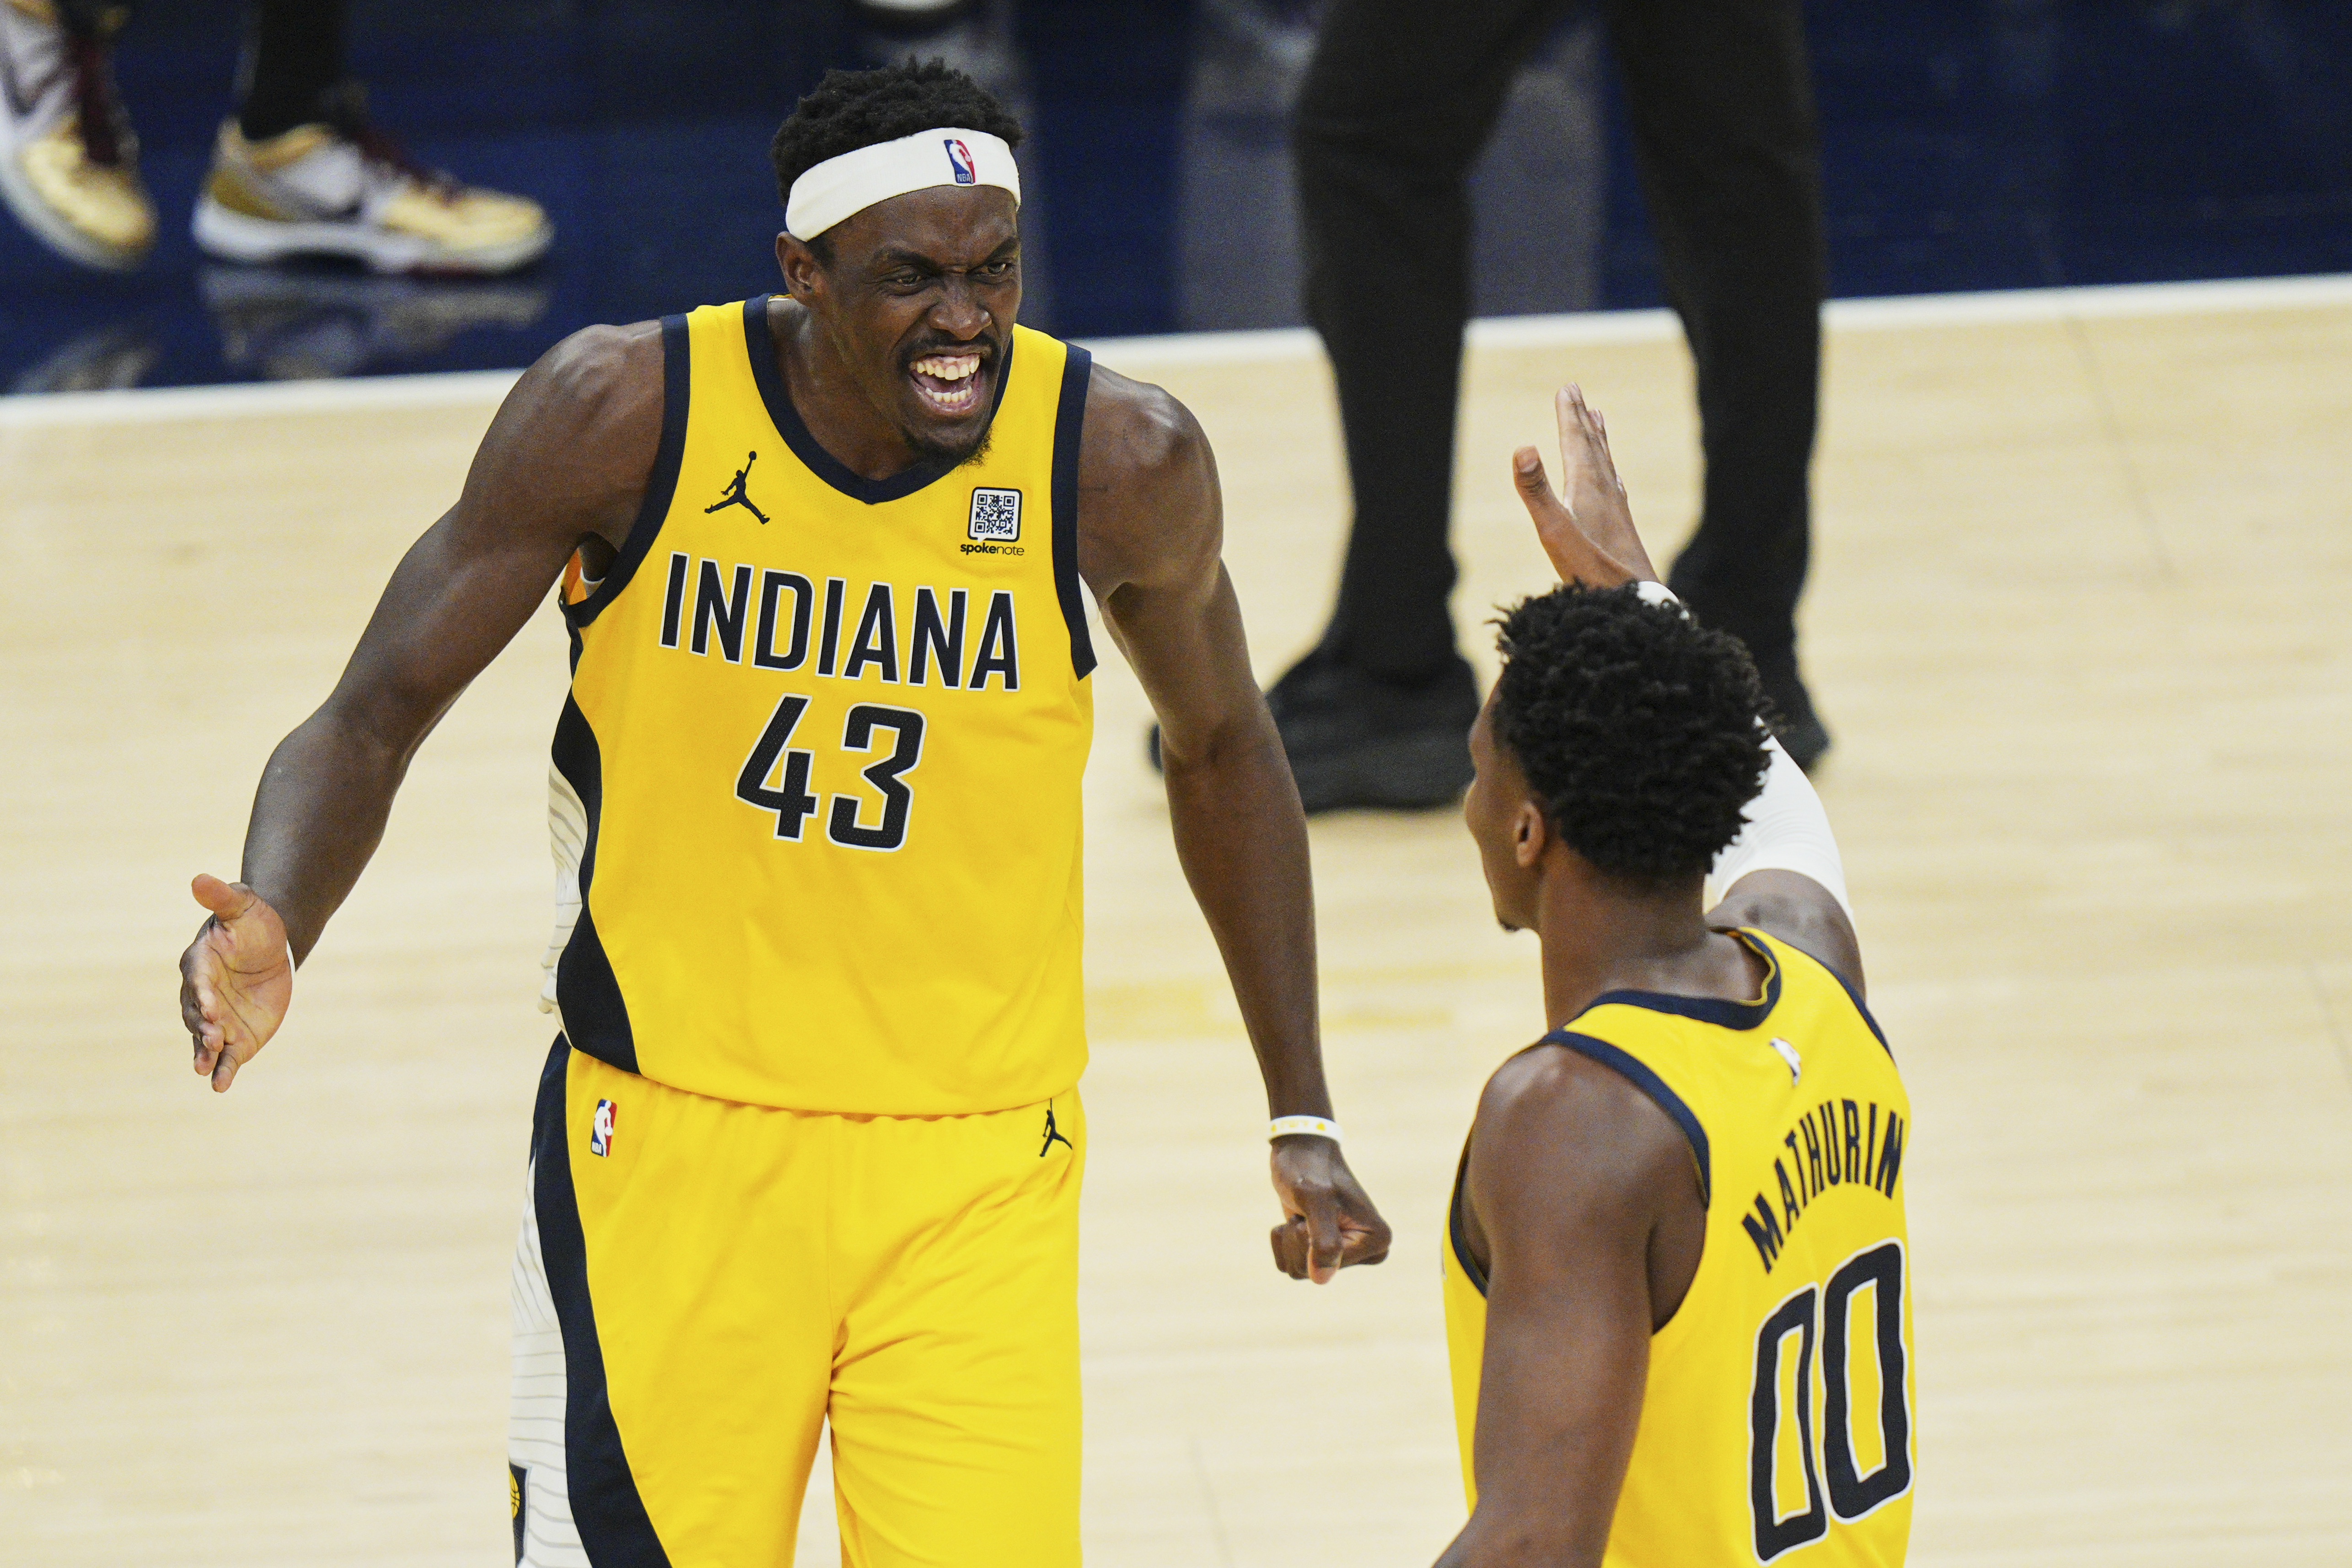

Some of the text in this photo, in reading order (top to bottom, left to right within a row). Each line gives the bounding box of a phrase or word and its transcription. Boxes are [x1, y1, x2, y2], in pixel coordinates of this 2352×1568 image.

[957, 173, 971, 182] NBA
[960, 542, 1025, 556] spokenote
[659, 550, 1020, 692] INDIANA
[735, 693, 927, 852] 43
[591, 1141, 602, 1154] NBA
[1741, 1098, 1904, 1273] MATHURIN
[1748, 1237, 1914, 1566] 00
